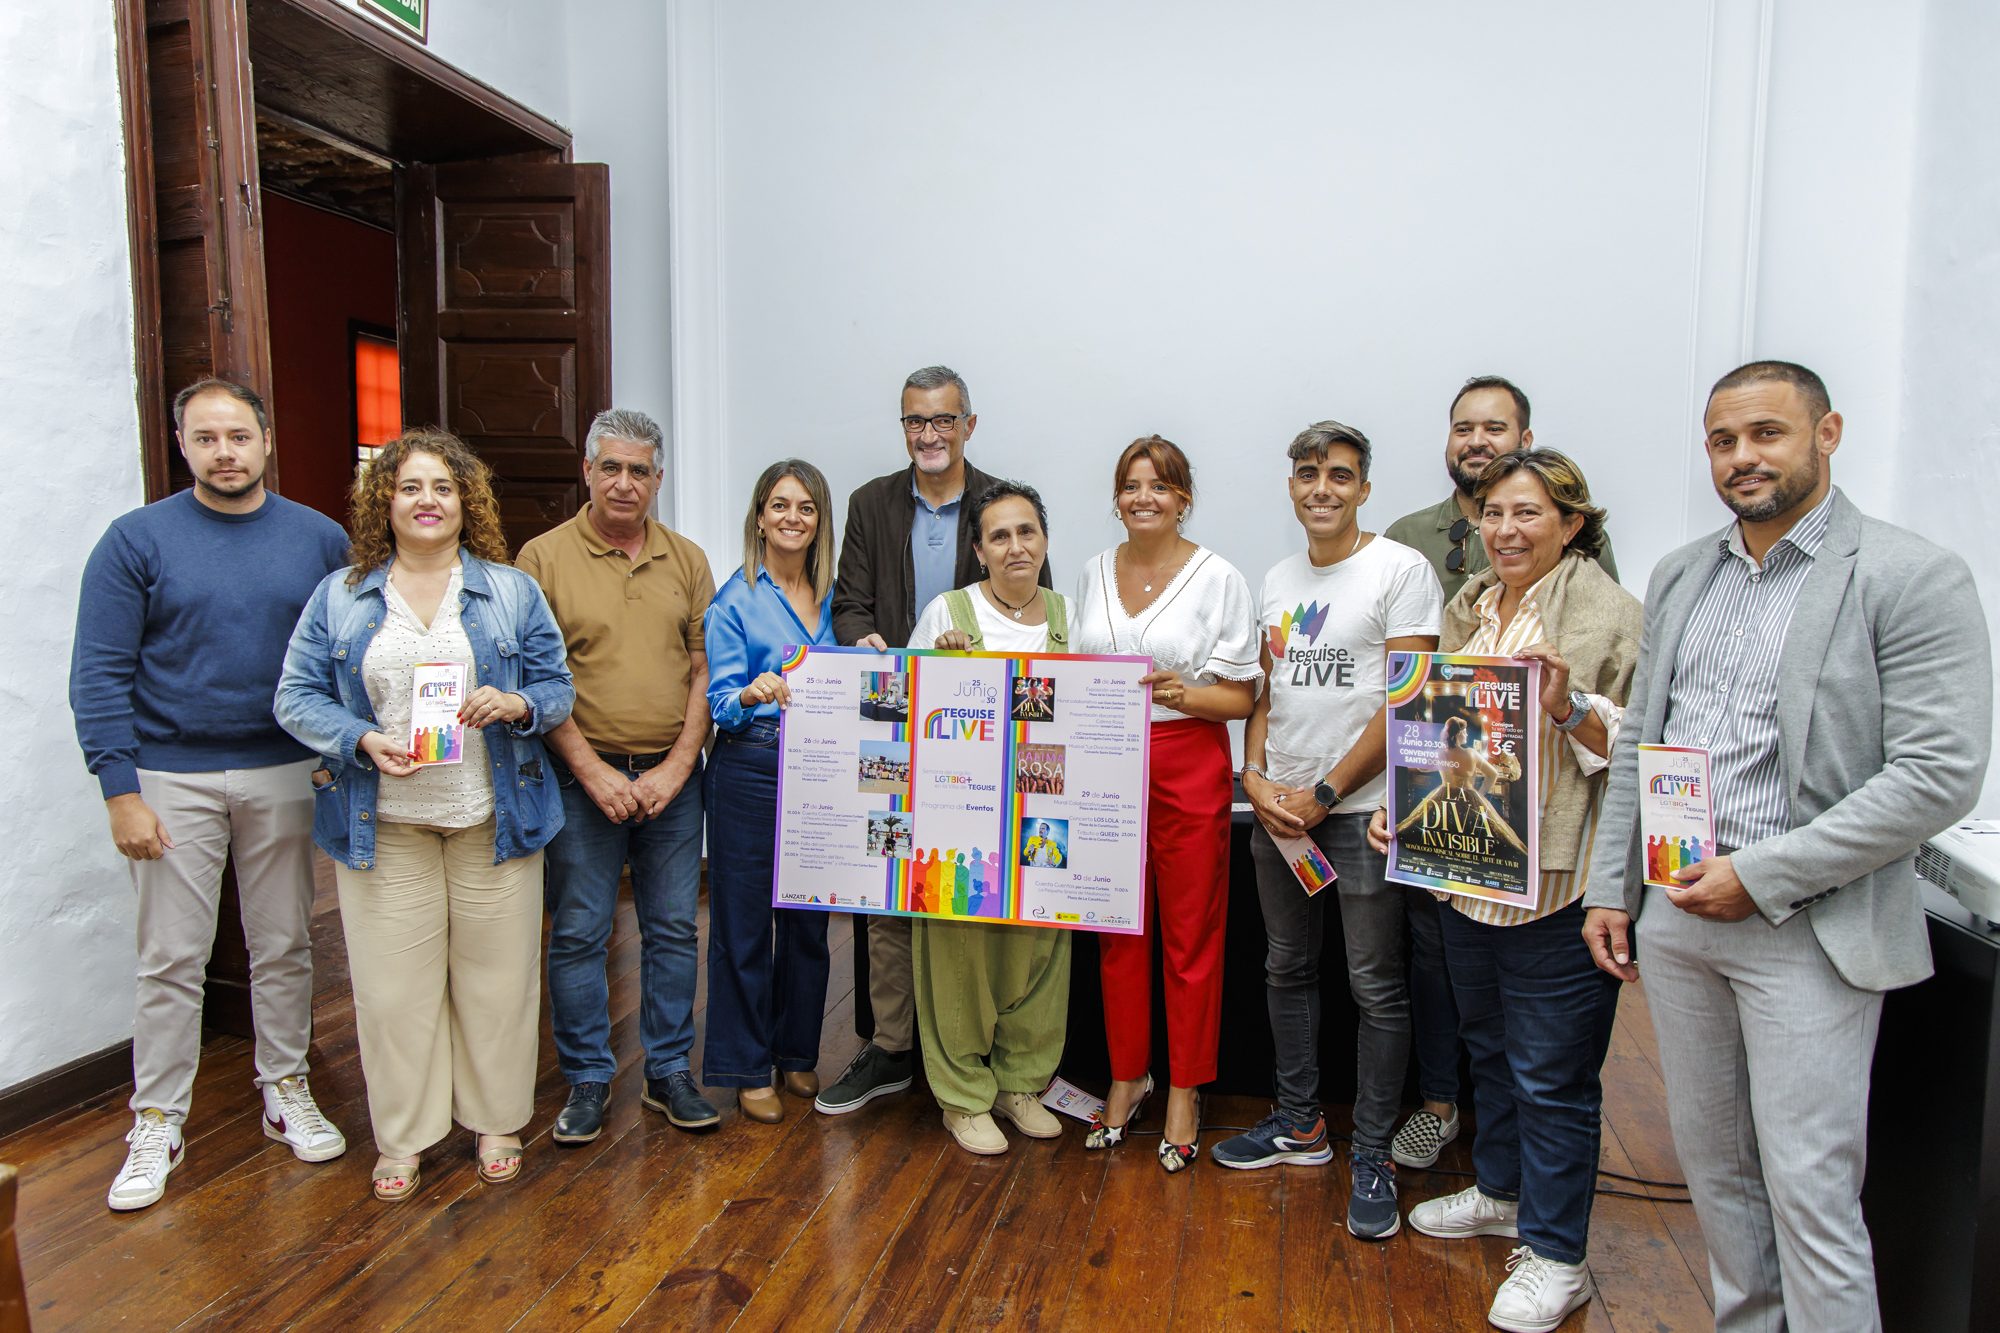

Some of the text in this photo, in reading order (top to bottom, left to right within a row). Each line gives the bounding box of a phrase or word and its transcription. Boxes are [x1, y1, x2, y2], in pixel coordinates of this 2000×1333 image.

[1288, 643, 1355, 666] teguise.
[1291, 663, 1354, 687] LIVE
[426, 686, 456, 698] LIVE
[953, 682, 998, 697] Junio
[1479, 682, 1520, 692] TEGUISE
[1475, 690, 1520, 710] LIVE
[942, 708, 995, 719] TEGUISE
[937, 718, 994, 741] LIVE
[1404, 725, 1420, 738] 28
[1402, 738, 1423, 747] Junio
[1491, 739, 1516, 756] 3€
[1018, 752, 1064, 762] CALIMA
[1400, 748, 1434, 758] CONVENTO
[1405, 756, 1460, 768] SANTO DOMINGO
[1669, 757, 1700, 769] Junio
[1018, 760, 1064, 780] ROSA
[1662, 774, 1700, 784] TEGUISE
[1446, 782, 1467, 802] LA
[1659, 782, 1701, 798] LIVE
[1422, 799, 1494, 838] DIVA
[1423, 829, 1496, 857] INVISIBLE
